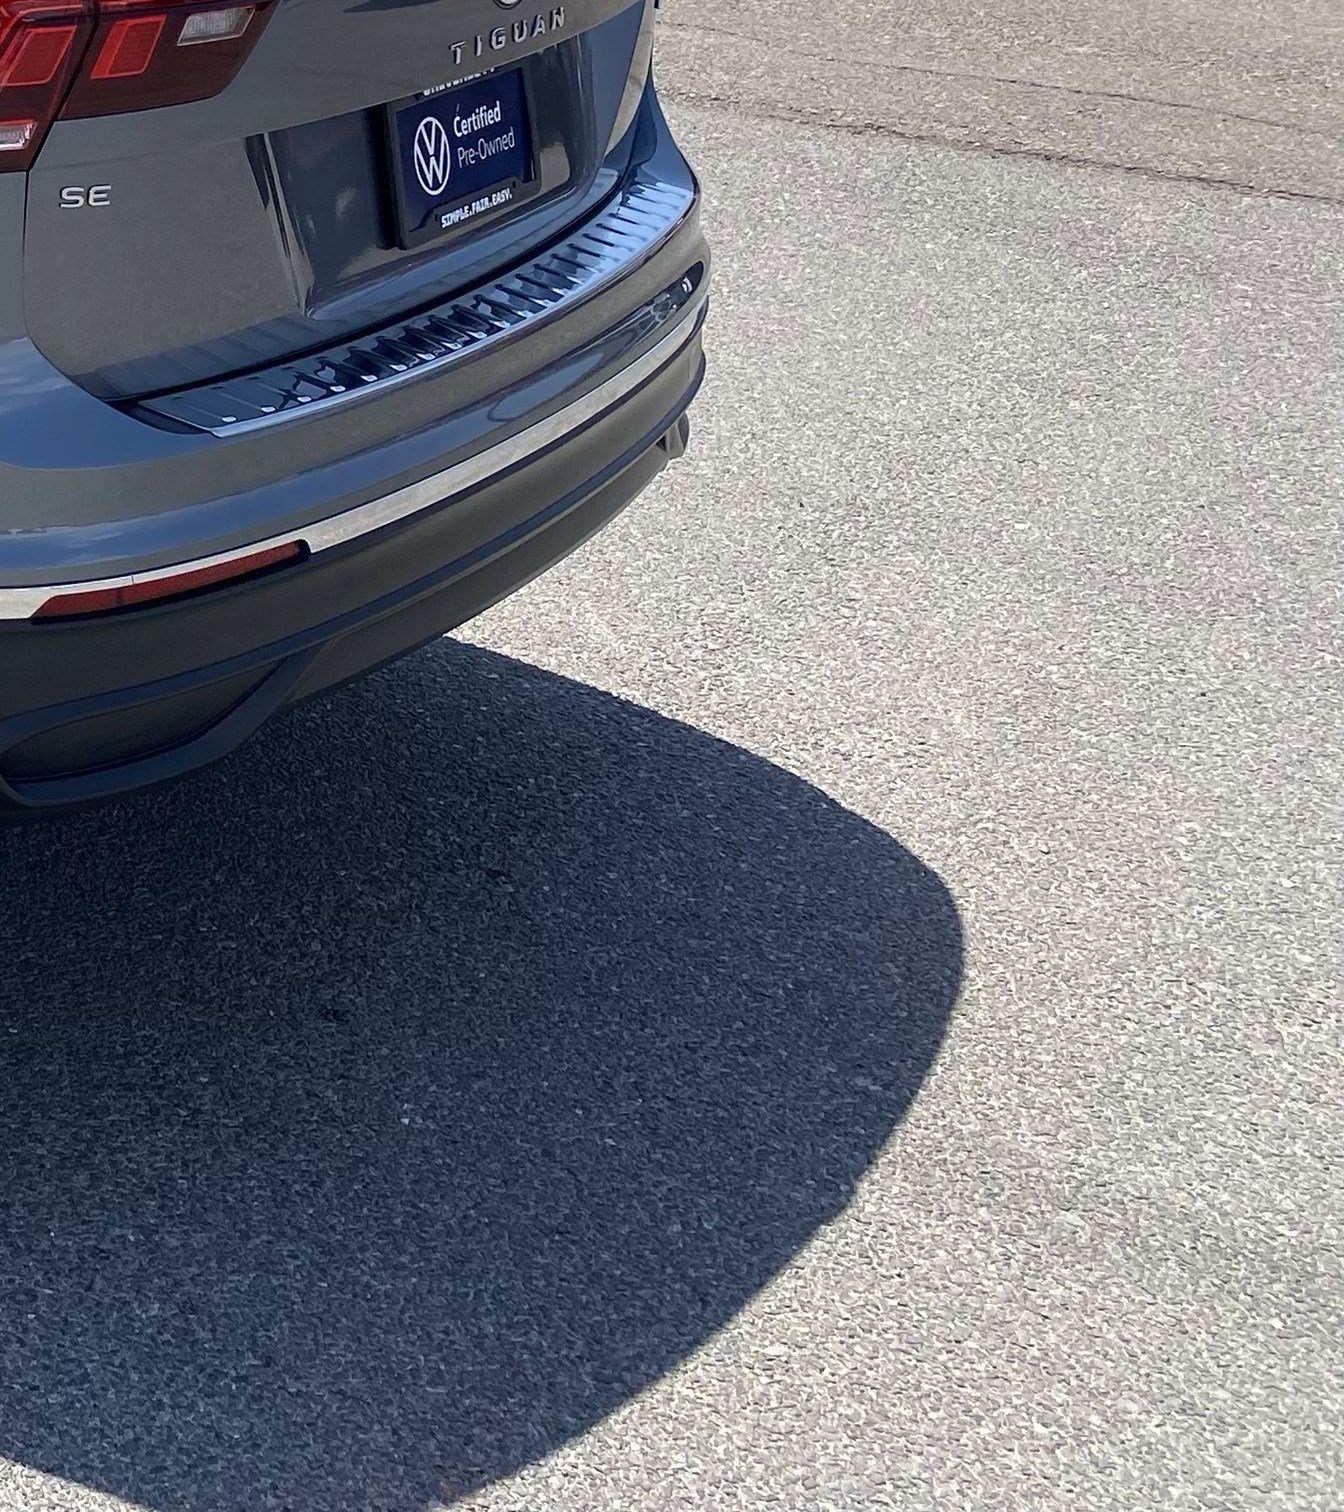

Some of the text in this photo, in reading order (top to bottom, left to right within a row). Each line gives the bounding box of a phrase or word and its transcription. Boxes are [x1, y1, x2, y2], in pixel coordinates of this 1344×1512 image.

[449, 6, 566, 65] TIGUAN
[453, 100, 502, 138] Certified
[457, 126, 516, 169] Pre-Owned
[58, 184, 112, 208] SE
